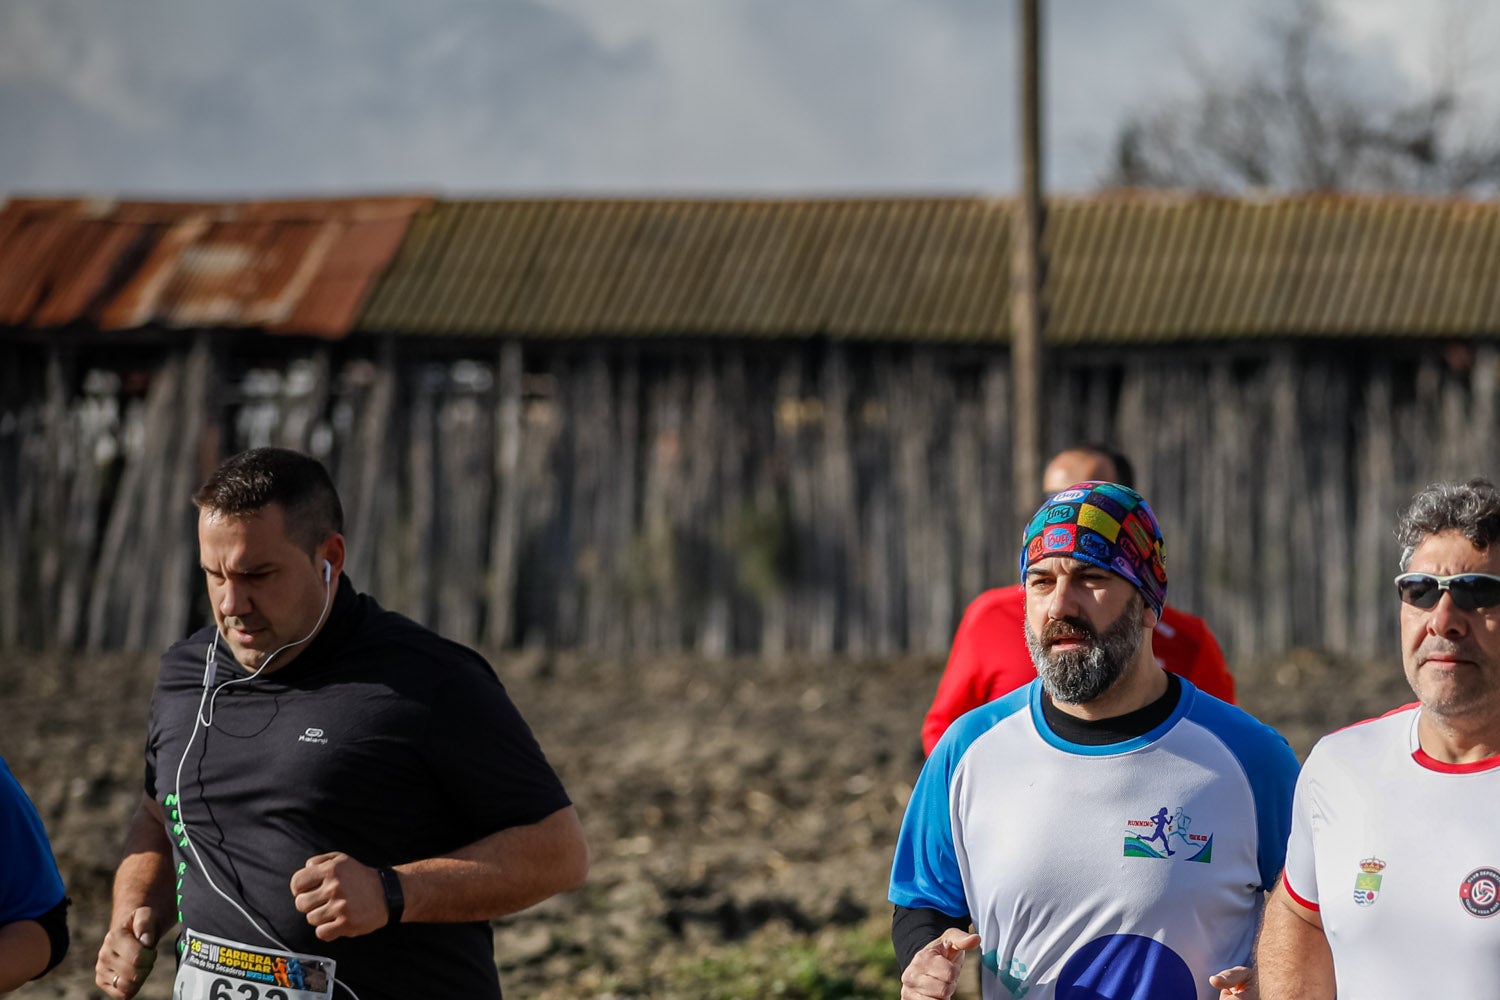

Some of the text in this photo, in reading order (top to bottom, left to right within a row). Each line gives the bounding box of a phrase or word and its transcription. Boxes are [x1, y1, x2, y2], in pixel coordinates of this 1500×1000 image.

[1047, 507, 1071, 520] Buff
[1047, 533, 1071, 548] Buff
[219, 947, 271, 966] CARRERA
[216, 963, 246, 977] Secaderos
[218, 956, 271, 974] POPULAR
